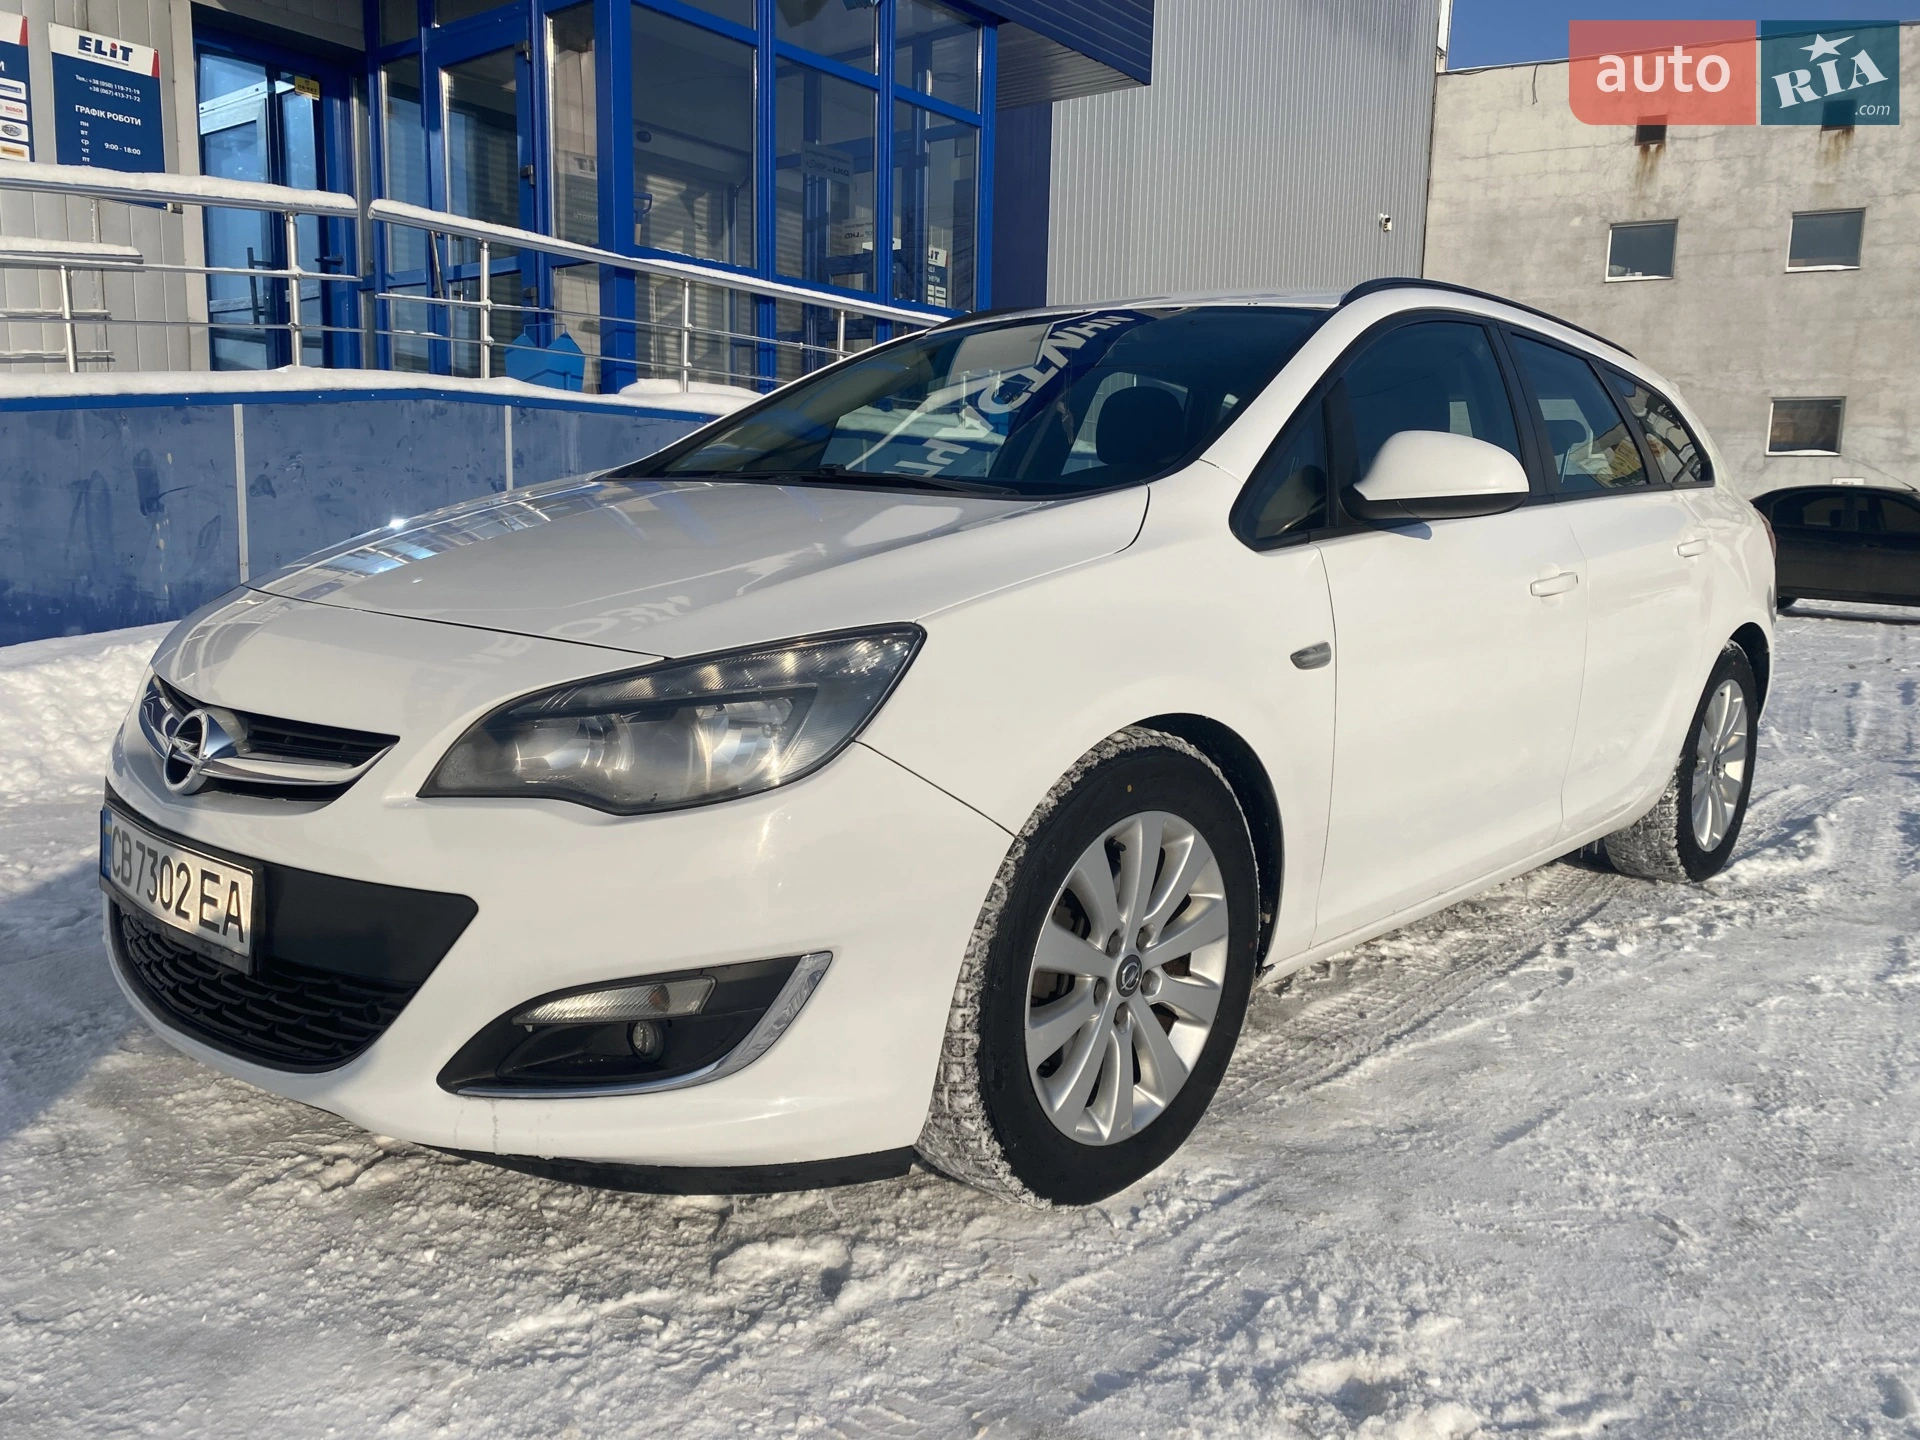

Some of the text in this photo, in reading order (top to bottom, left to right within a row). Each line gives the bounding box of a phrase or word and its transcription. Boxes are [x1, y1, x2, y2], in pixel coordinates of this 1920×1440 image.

[100, 80, 113, 89] (050)
[114, 84, 140, 95] 119-71-19
[114, 91, 140, 103] 413-71-72
[75, 105, 142, 127] ГРАФІК РОБОТИ
[104, 142, 119, 152] 9:00
[123, 146, 141, 156] 18:00
